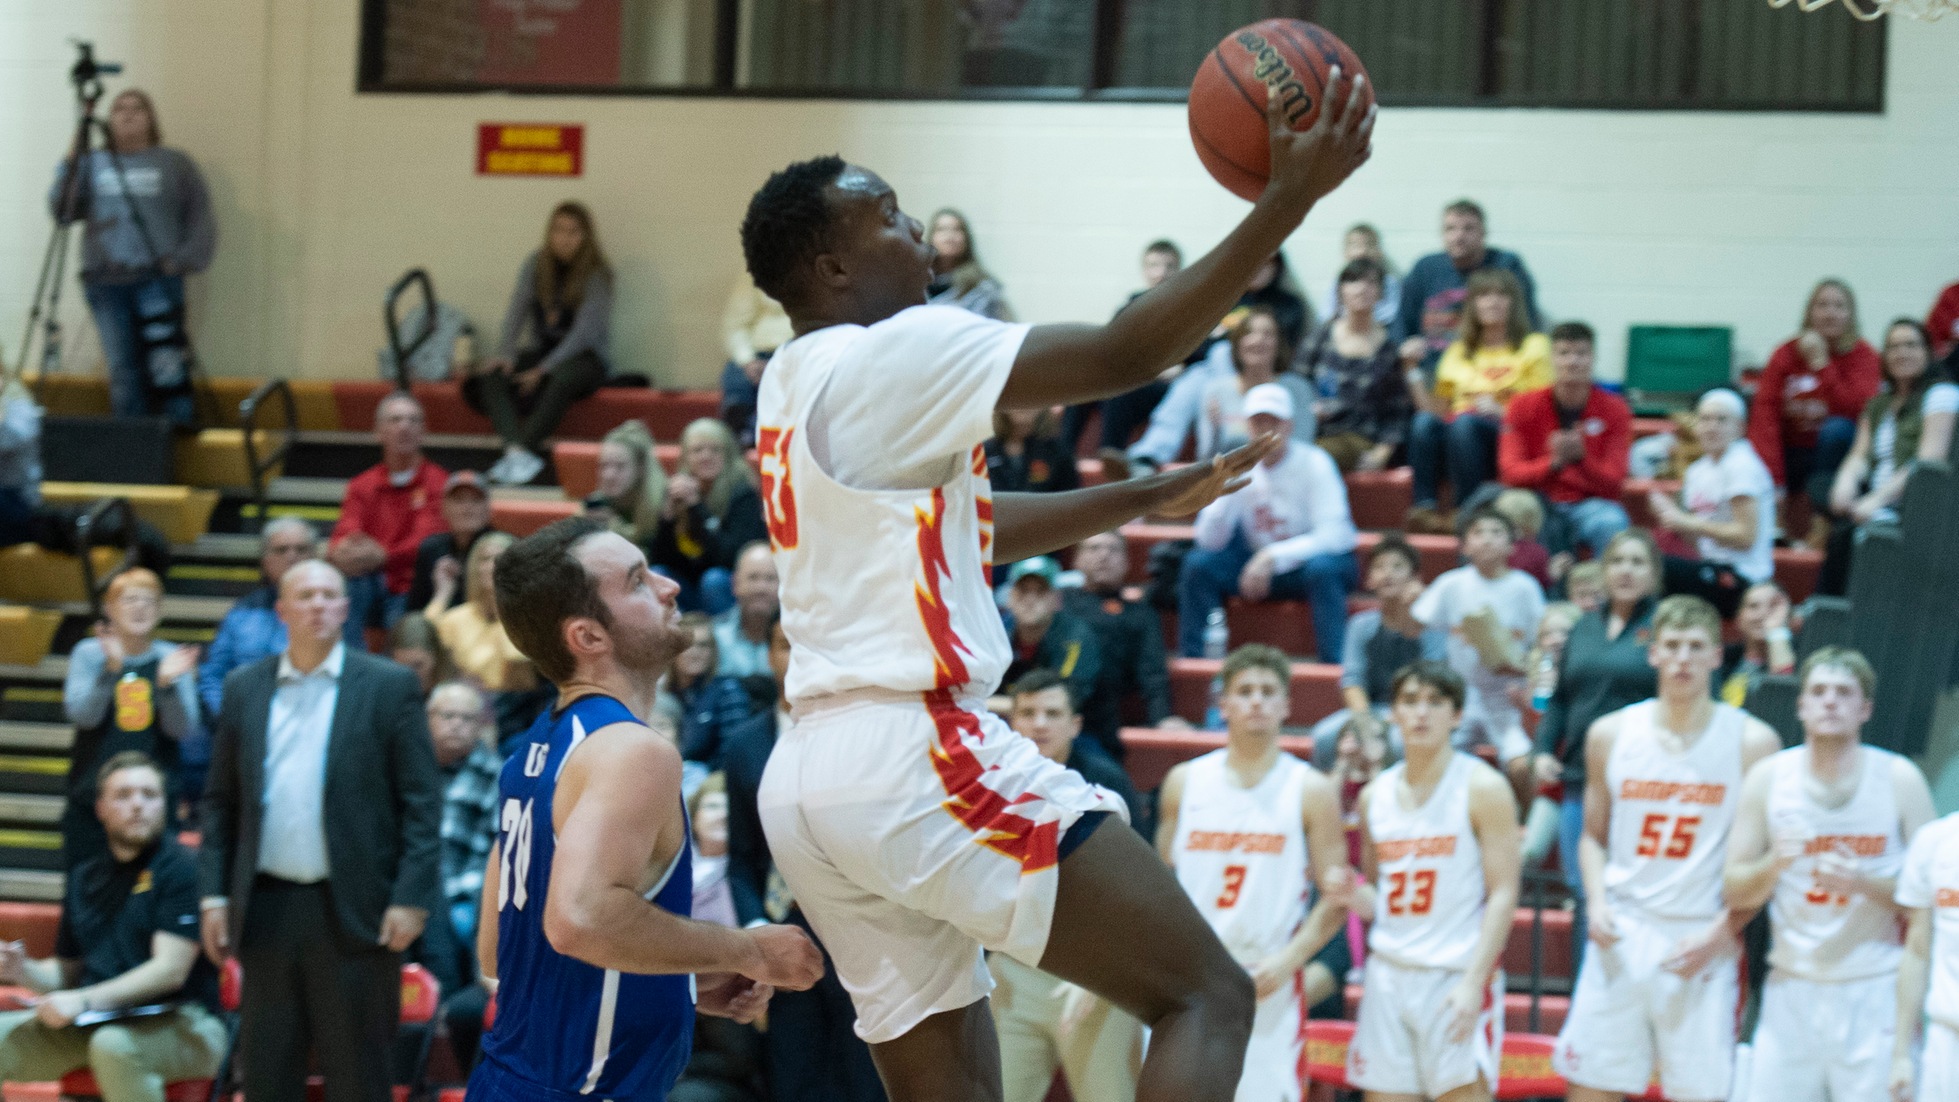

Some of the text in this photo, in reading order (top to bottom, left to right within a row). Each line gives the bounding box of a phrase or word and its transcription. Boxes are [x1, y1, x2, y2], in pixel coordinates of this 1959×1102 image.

[1236, 31, 1313, 124] Wilson
[1620, 779, 1727, 806] SIMPSON
[1185, 829, 1286, 855] SIMPSON
[1376, 835, 1457, 862] IMPSON
[1635, 813, 1703, 859] 55
[1215, 865, 1247, 909] 3
[1387, 870, 1438, 917] 23
